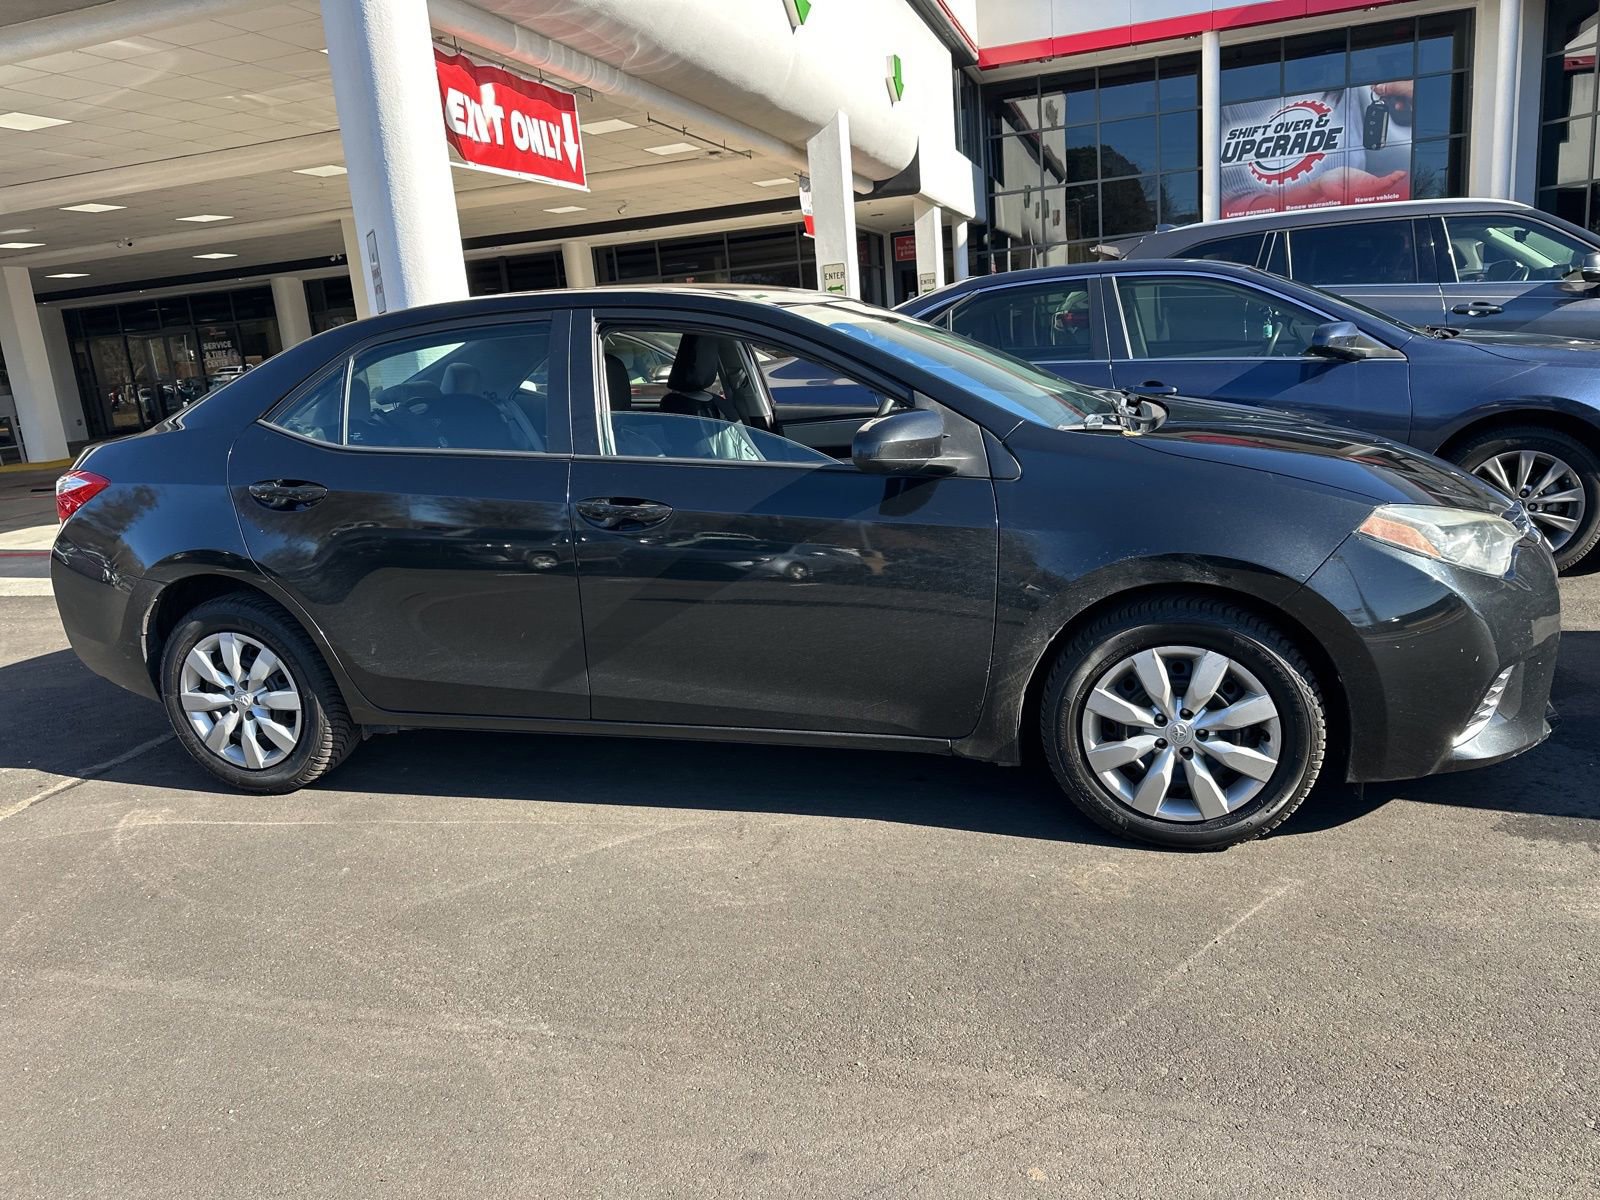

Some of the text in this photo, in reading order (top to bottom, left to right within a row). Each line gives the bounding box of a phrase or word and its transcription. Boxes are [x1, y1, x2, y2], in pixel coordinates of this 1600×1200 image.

[445, 87, 563, 162] EXIT ONLY
[1226, 113, 1330, 140] SHIFT OVER &
[1221, 127, 1343, 163] UPGRADE
[1307, 199, 1341, 208] warranties
[1354, 193, 1400, 204] Newer vehicle
[1226, 207, 1276, 219] Lower payments
[825, 272, 845, 280] ENTER
[203, 341, 232, 350] SERVICE
